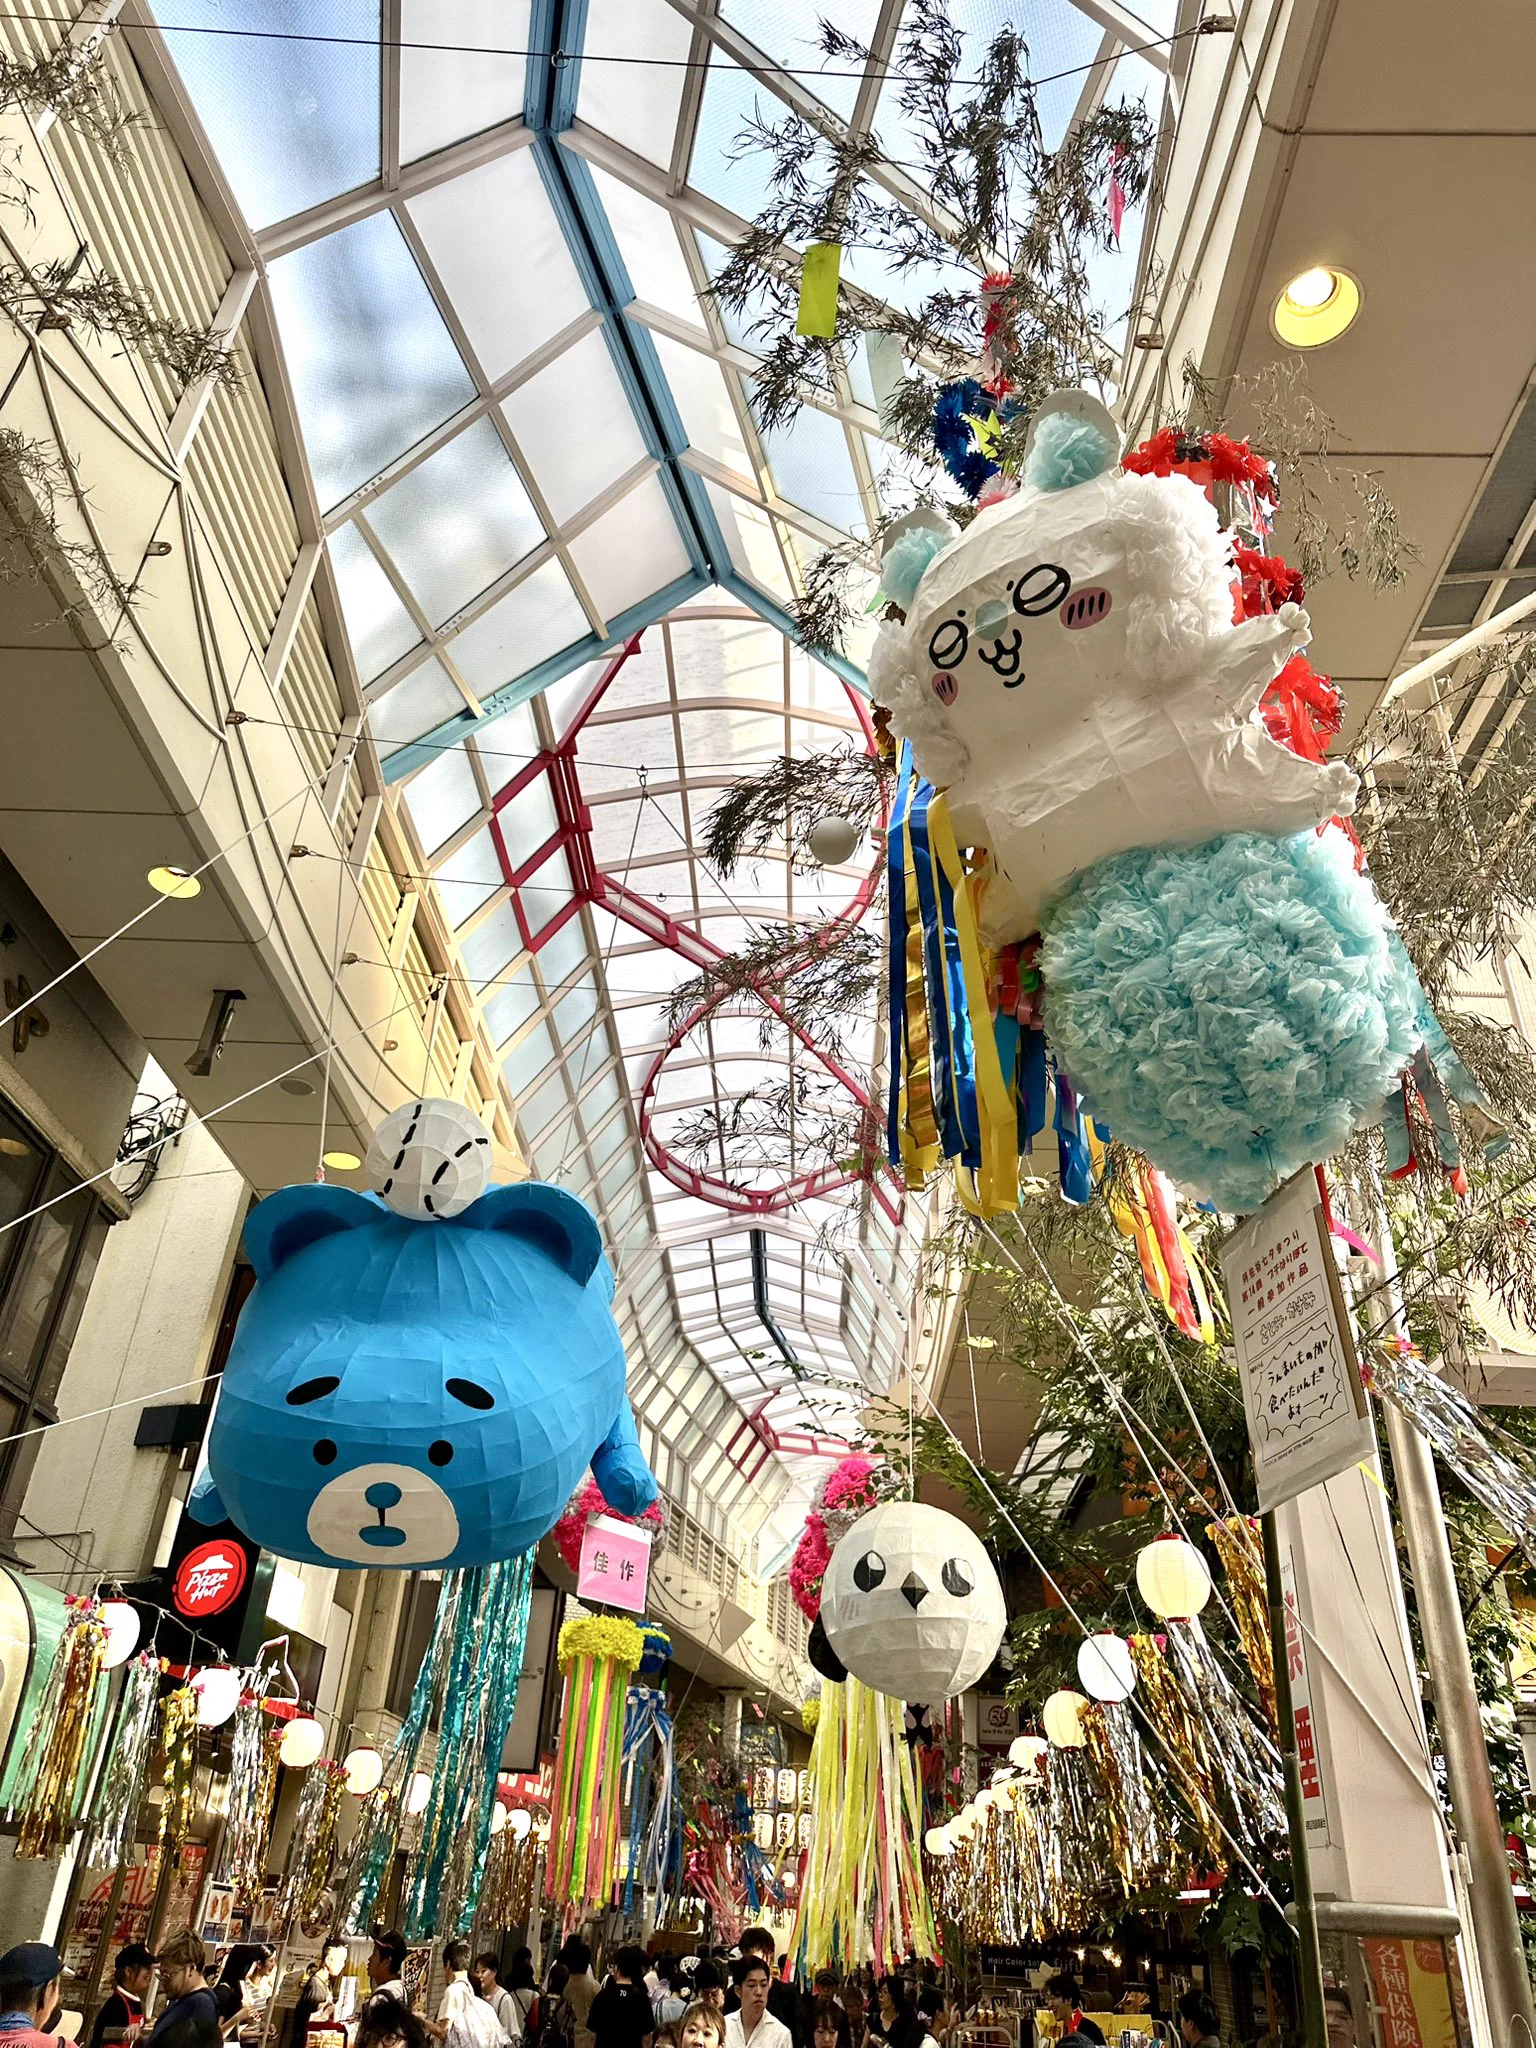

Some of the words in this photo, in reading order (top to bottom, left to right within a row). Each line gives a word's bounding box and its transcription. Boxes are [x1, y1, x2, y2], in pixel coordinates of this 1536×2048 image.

[593, 1551, 634, 1581] 佳作
[185, 1570, 229, 1592] Pizza
[190, 1583, 225, 1604] Hut
[988, 1957, 1003, 1966] Hair
[1005, 1957, 1026, 1967] Color
[619, 1989, 627, 1997] 70
[1375, 1945, 1419, 2047] 各種保険
